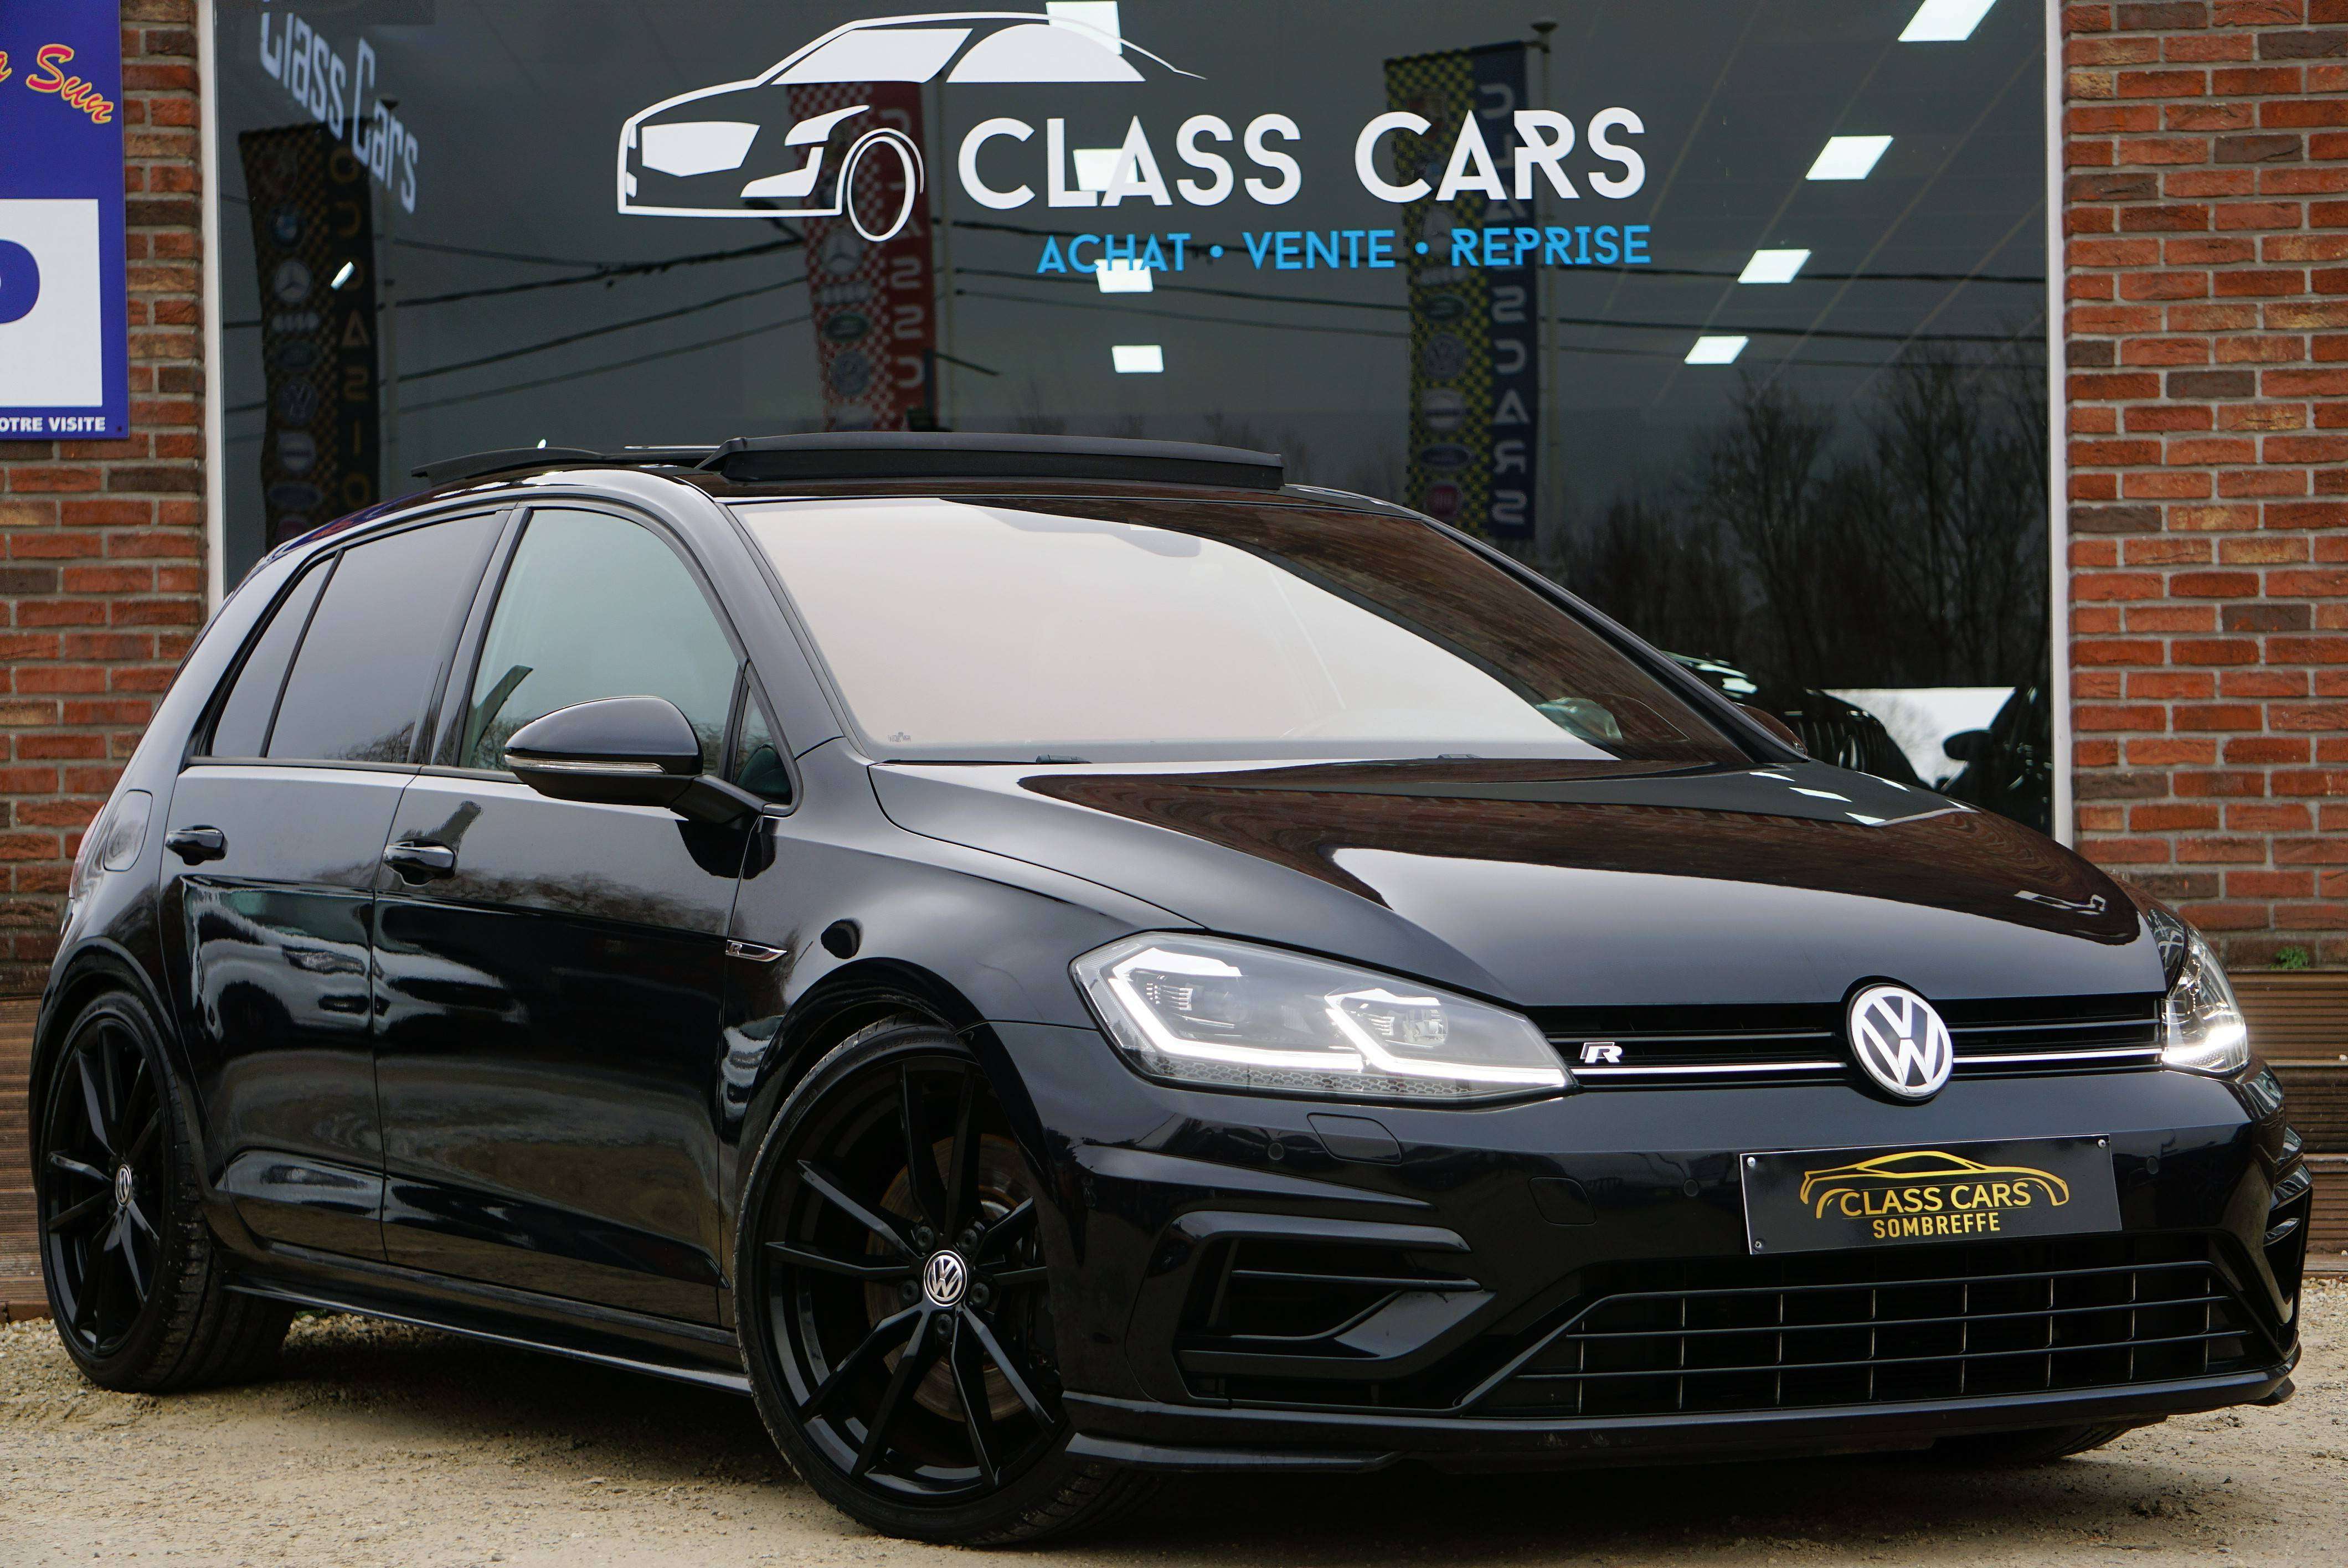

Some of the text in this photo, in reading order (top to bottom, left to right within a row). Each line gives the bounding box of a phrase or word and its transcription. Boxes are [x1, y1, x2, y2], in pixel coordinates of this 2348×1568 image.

[26, 44, 114, 123] Sun
[352, 37, 418, 214] Cars
[958, 107, 1646, 209] CLASS CARS
[1037, 225, 1651, 274] ACHAT VENTE REPRISE
[48, 416, 106, 432] VISITE
[1580, 1041, 1623, 1064] R
[1840, 1182, 2032, 1217] CLASS CARS
[1872, 1212, 2001, 1239] SOMBREFFE
